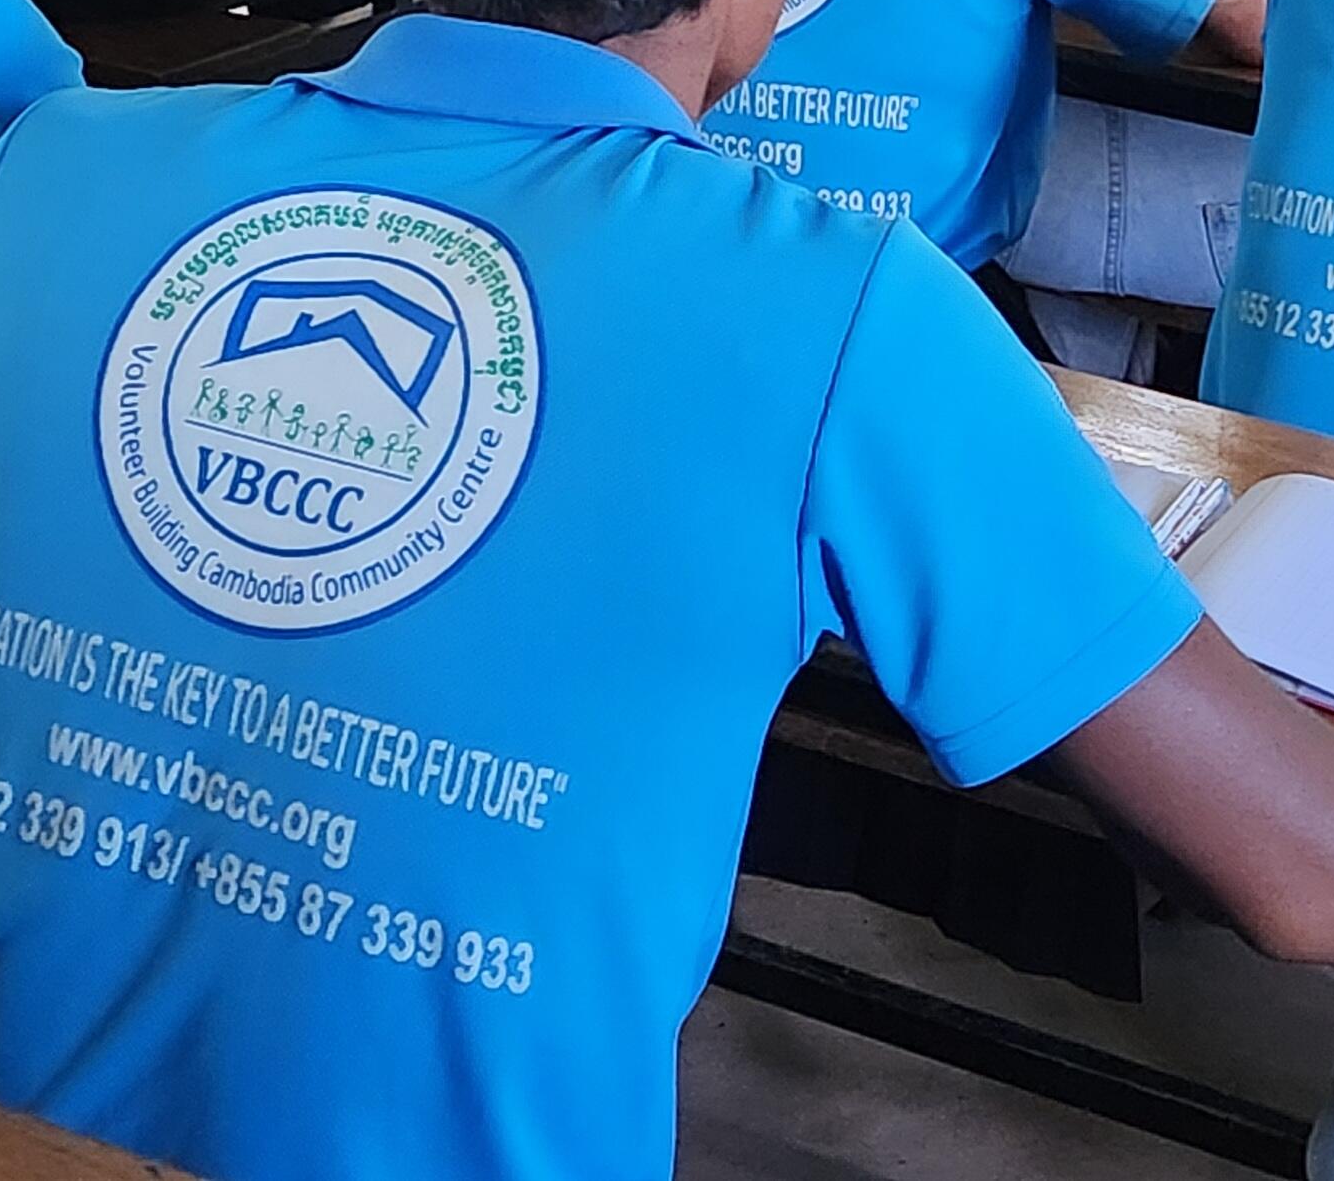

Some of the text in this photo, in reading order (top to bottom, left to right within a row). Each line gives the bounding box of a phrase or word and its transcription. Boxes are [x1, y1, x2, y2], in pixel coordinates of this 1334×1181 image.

[739, 80, 756, 116] A
[755, 82, 830, 125] BETTER
[871, 191, 912, 221] 933
[1273, 300, 1302, 338] 12
[118, 344, 503, 606] Volunteer Building Cambodia Community Centre
[196, 444, 365, 535] VBCCC
[69, 632, 97, 693] IS
[104, 641, 160, 714] THE
[161, 661, 224, 725] KEY
[226, 676, 267, 745] TO
[266, 694, 290, 755] A
[287, 699, 418, 792] BETTER
[46, 722, 358, 870] www.vbccc.org
[18, 790, 86, 859] 339
[94, 815, 189, 887] 913/
[195, 852, 291, 924] +855
[297, 881, 356, 944] 87
[360, 903, 445, 970] 339
[453, 928, 537, 996] 933
